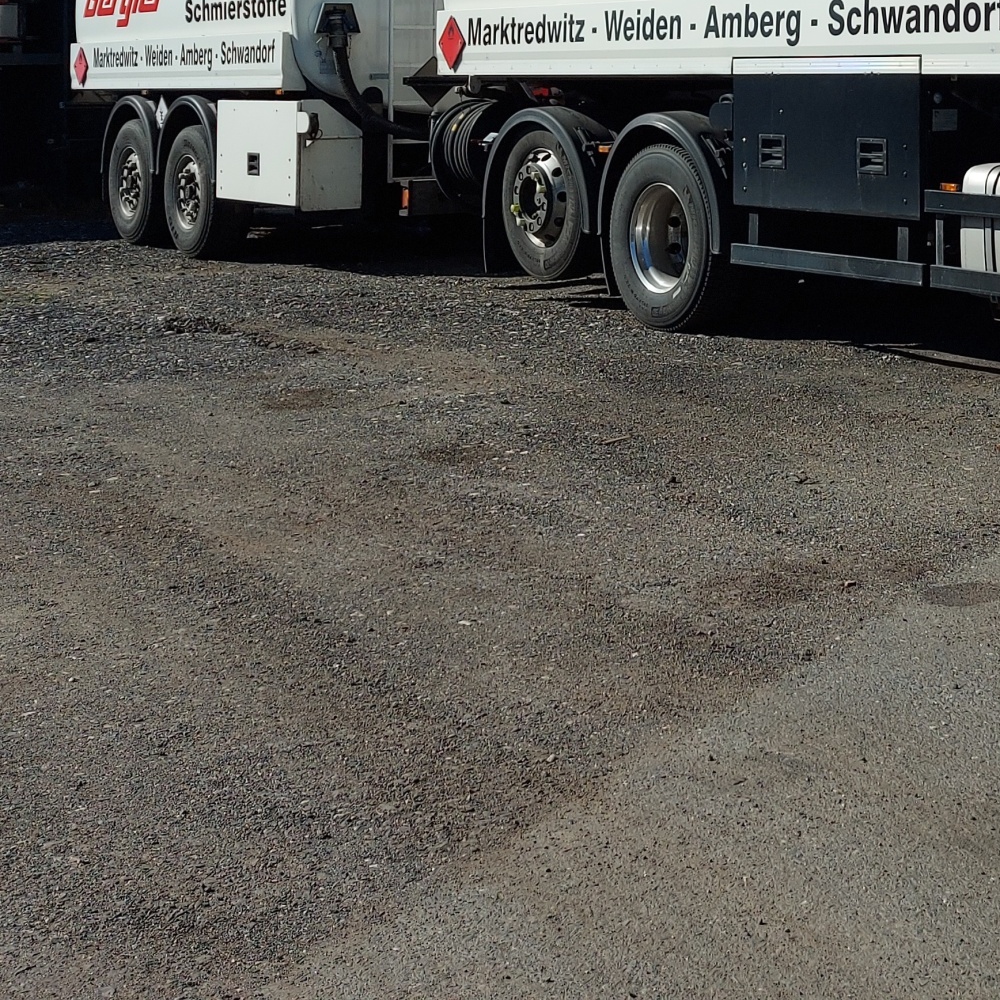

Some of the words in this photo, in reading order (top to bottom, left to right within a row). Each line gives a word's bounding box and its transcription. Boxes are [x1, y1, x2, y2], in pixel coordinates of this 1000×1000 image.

[467, 13, 585, 46] Marktredwitz
[604, 8, 682, 42] Weiden
[703, 3, 801, 46] Amberg
[93, 46, 138, 68] Marktredwitz
[144, 44, 173, 67] Weiden
[180, 43, 213, 71] Amberg
[221, 38, 276, 65] Schwandorf
